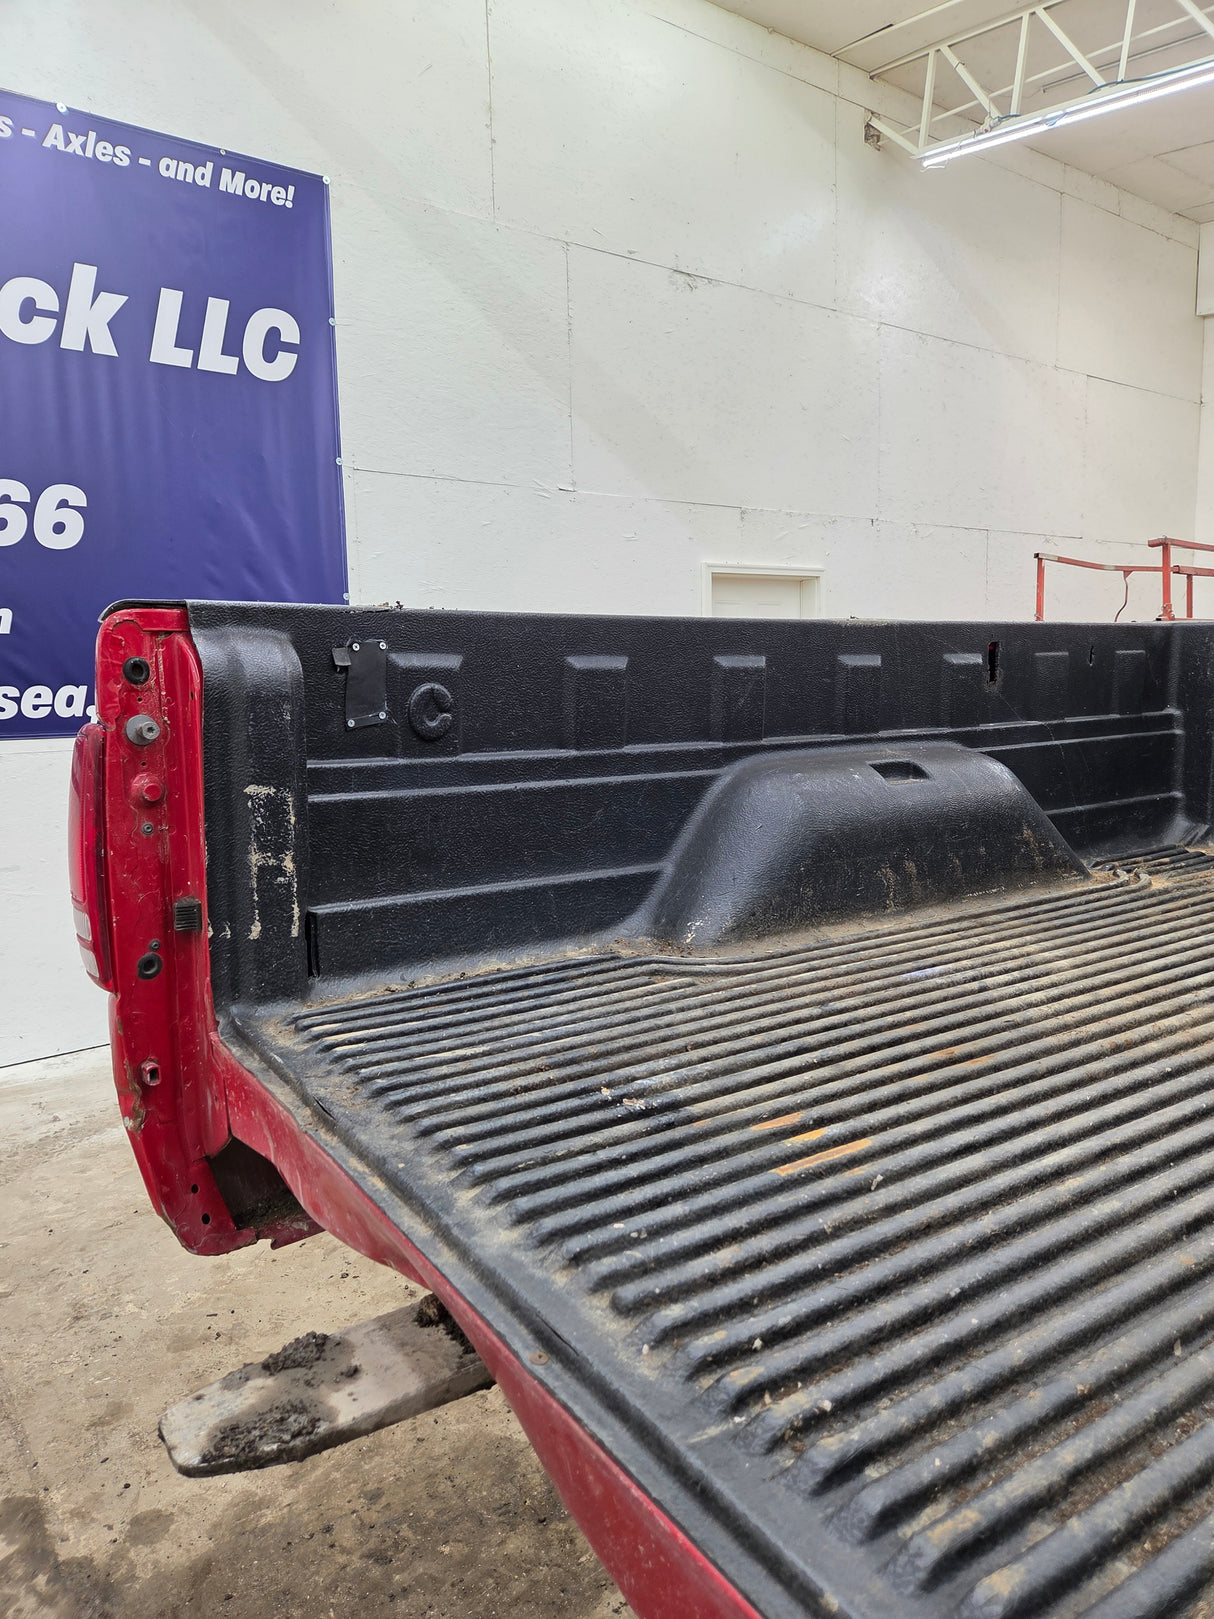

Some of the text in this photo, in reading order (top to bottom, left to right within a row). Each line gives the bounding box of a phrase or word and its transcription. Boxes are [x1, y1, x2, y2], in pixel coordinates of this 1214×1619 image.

[42, 123, 131, 166] Axles
[159, 156, 213, 187] and
[219, 167, 295, 208] More!
[0, 262, 300, 382] ck LLC
[0, 478, 87, 550] 66
